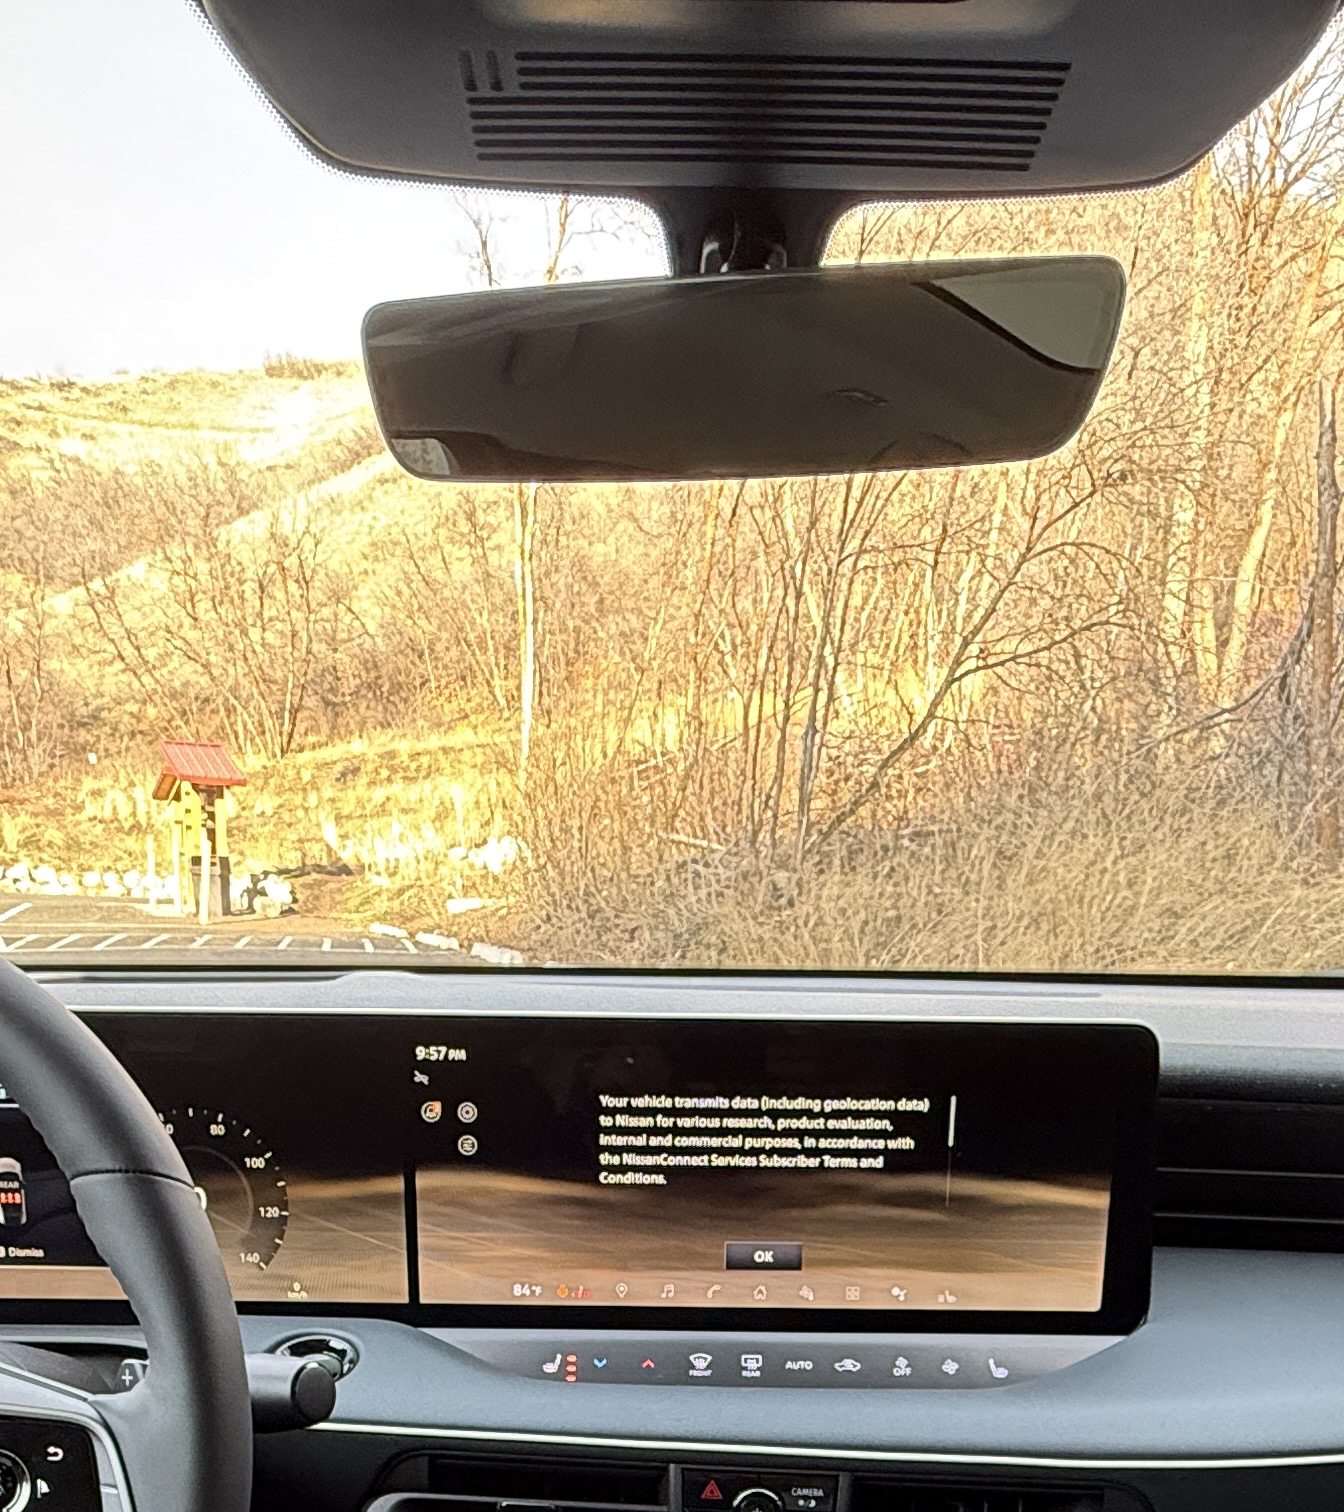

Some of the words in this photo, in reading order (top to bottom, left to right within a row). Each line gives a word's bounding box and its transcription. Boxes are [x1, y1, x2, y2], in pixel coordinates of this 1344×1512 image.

[416, 1046, 447, 1061] 9:57
[599, 1095, 629, 1108] Your
[630, 1094, 672, 1108] vehicle
[674, 1096, 729, 1109] transmits
[731, 1096, 759, 1109] data
[761, 1095, 822, 1112] (including
[823, 1096, 895, 1113] geolocation
[897, 1097, 930, 1113] data)
[599, 1114, 613, 1127] to
[615, 1114, 654, 1127] Nissan
[656, 1114, 674, 1128] for
[676, 1115, 720, 1128] various
[722, 1115, 775, 1130] research,
[777, 1116, 825, 1131] product
[826, 1116, 894, 1132] evaluation,
[210, 1124, 225, 1136] 80
[648, 1134, 672, 1147] and
[674, 1134, 743, 1147] commercial
[744, 1136, 802, 1150] purposes,
[803, 1136, 816, 1148] in
[818, 1136, 885, 1149] accordance
[887, 1136, 915, 1150] with
[244, 1157, 265, 1169] 100
[599, 1151, 620, 1165] the
[622, 1152, 709, 1166] NissanConnect
[711, 1153, 757, 1167] Services
[758, 1154, 821, 1168] Subscriber
[822, 1155, 858, 1168] Terms
[859, 1155, 884, 1168] and
[259, 1206, 279, 1218] 120
[239, 1252, 260, 1264] 140
[753, 1250, 774, 1264] OK
[785, 1360, 813, 1370] AUTO
[892, 1367, 912, 1377] OFF
[791, 1487, 824, 1497] CAMERA
